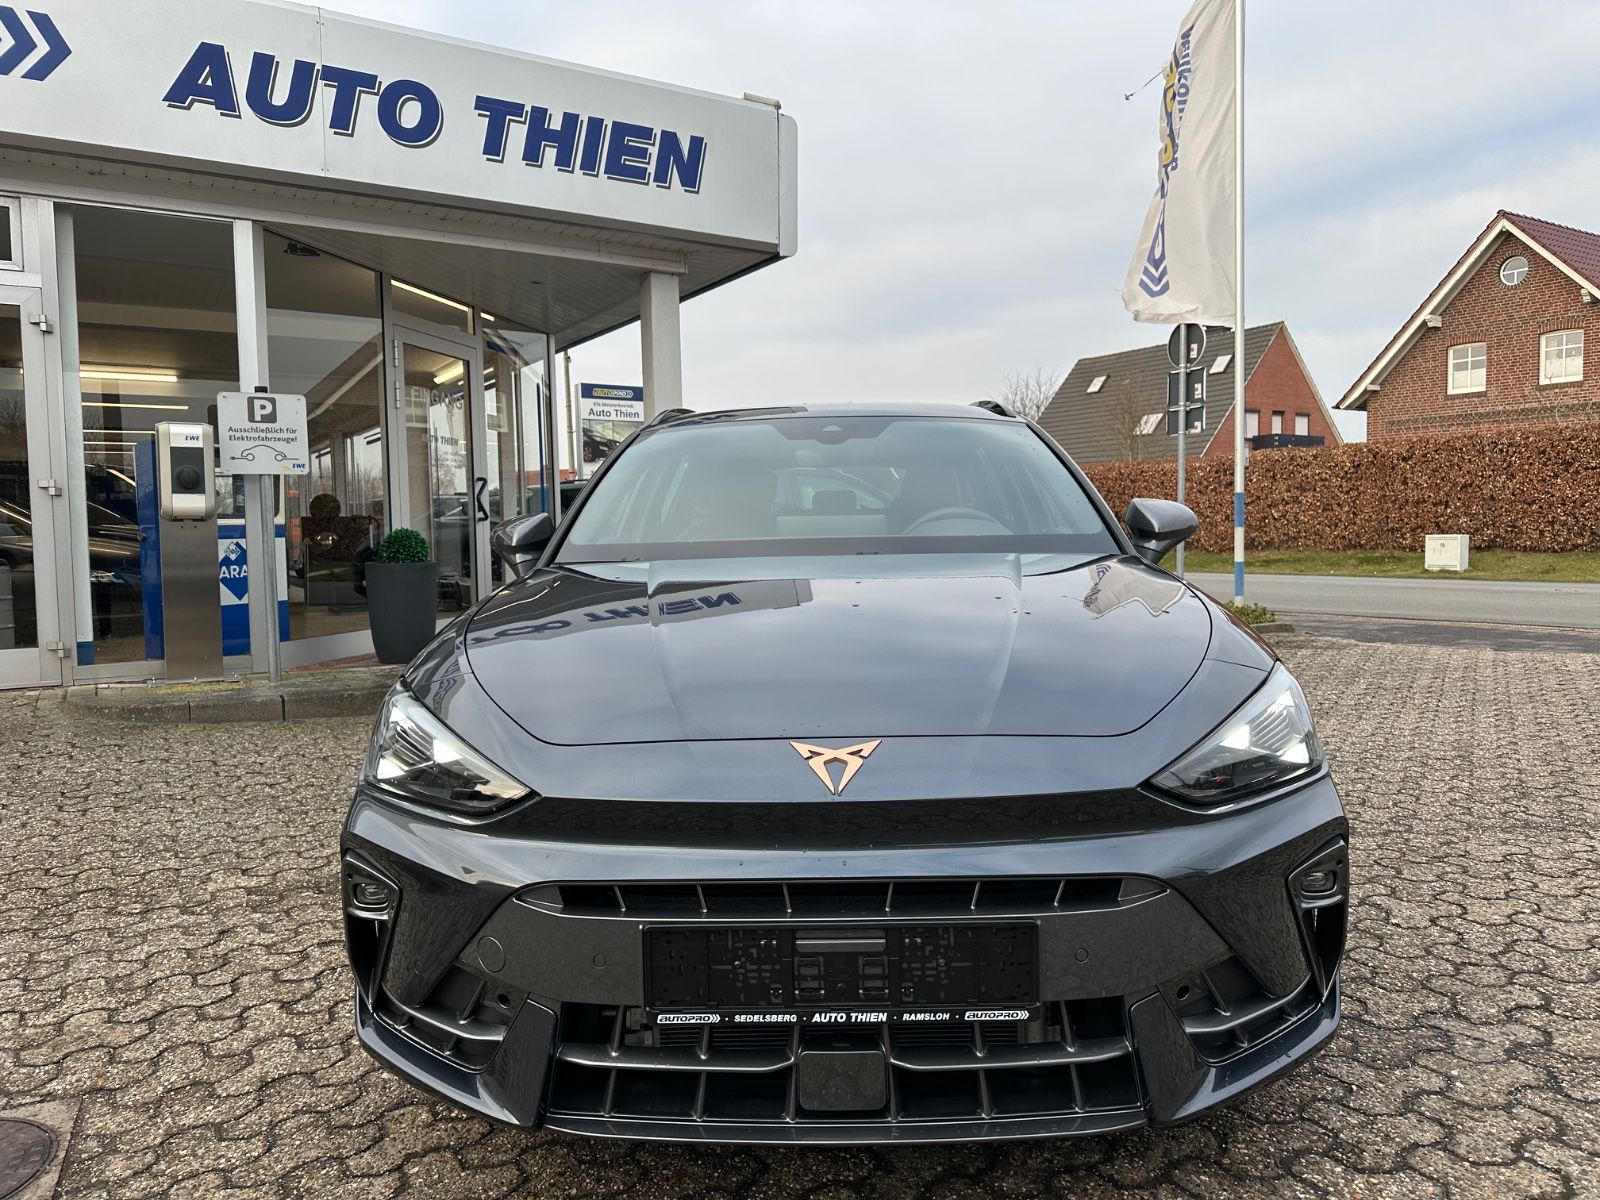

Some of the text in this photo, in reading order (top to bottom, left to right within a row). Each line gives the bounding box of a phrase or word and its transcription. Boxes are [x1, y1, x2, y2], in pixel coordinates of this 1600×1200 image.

[162, 41, 707, 195] AUTO THIEN
[411, 386, 463, 410] EINGANG
[253, 399, 272, 421] P
[588, 408, 640, 419] Auto Thien
[228, 426, 284, 434] Ausschließlich
[229, 435, 297, 444] Elektrofahrzeuge!
[219, 565, 248, 579] ARA
[734, 1014, 797, 1022] SEDELSBERG
[812, 1013, 846, 1022] AUTO
[850, 1012, 887, 1022] THIEN
[902, 1013, 950, 1021] RAMSLOH
